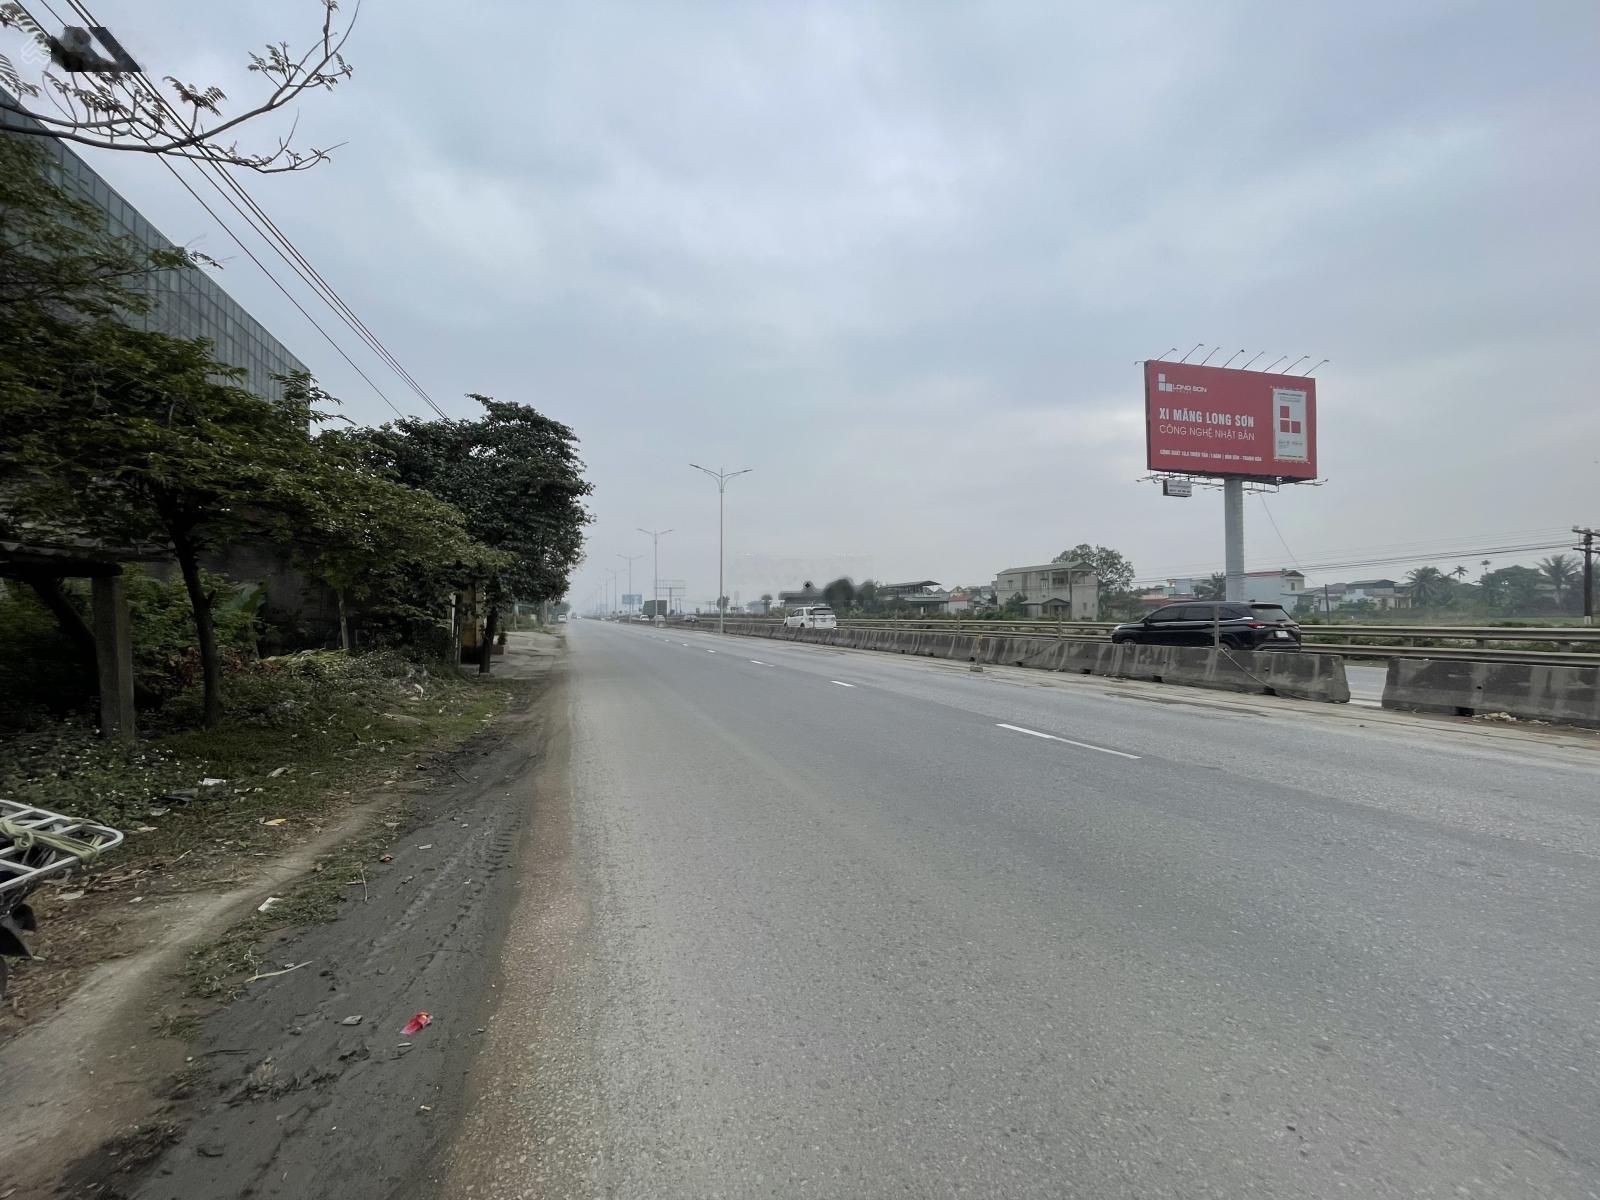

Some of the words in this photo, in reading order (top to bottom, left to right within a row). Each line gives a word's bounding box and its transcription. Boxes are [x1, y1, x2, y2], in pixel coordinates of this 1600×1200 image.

[1159, 407, 1169, 420] XI
[1173, 407, 1203, 423] MĂNG
[1206, 411, 1232, 426] LONG
[1235, 413, 1254, 427] SƠN
[1159, 423, 1187, 435] CÔNG
[1189, 427, 1213, 439] NGHỆ
[1214, 428, 1236, 441] NHẬT
[1238, 429, 1255, 441] BẢN
